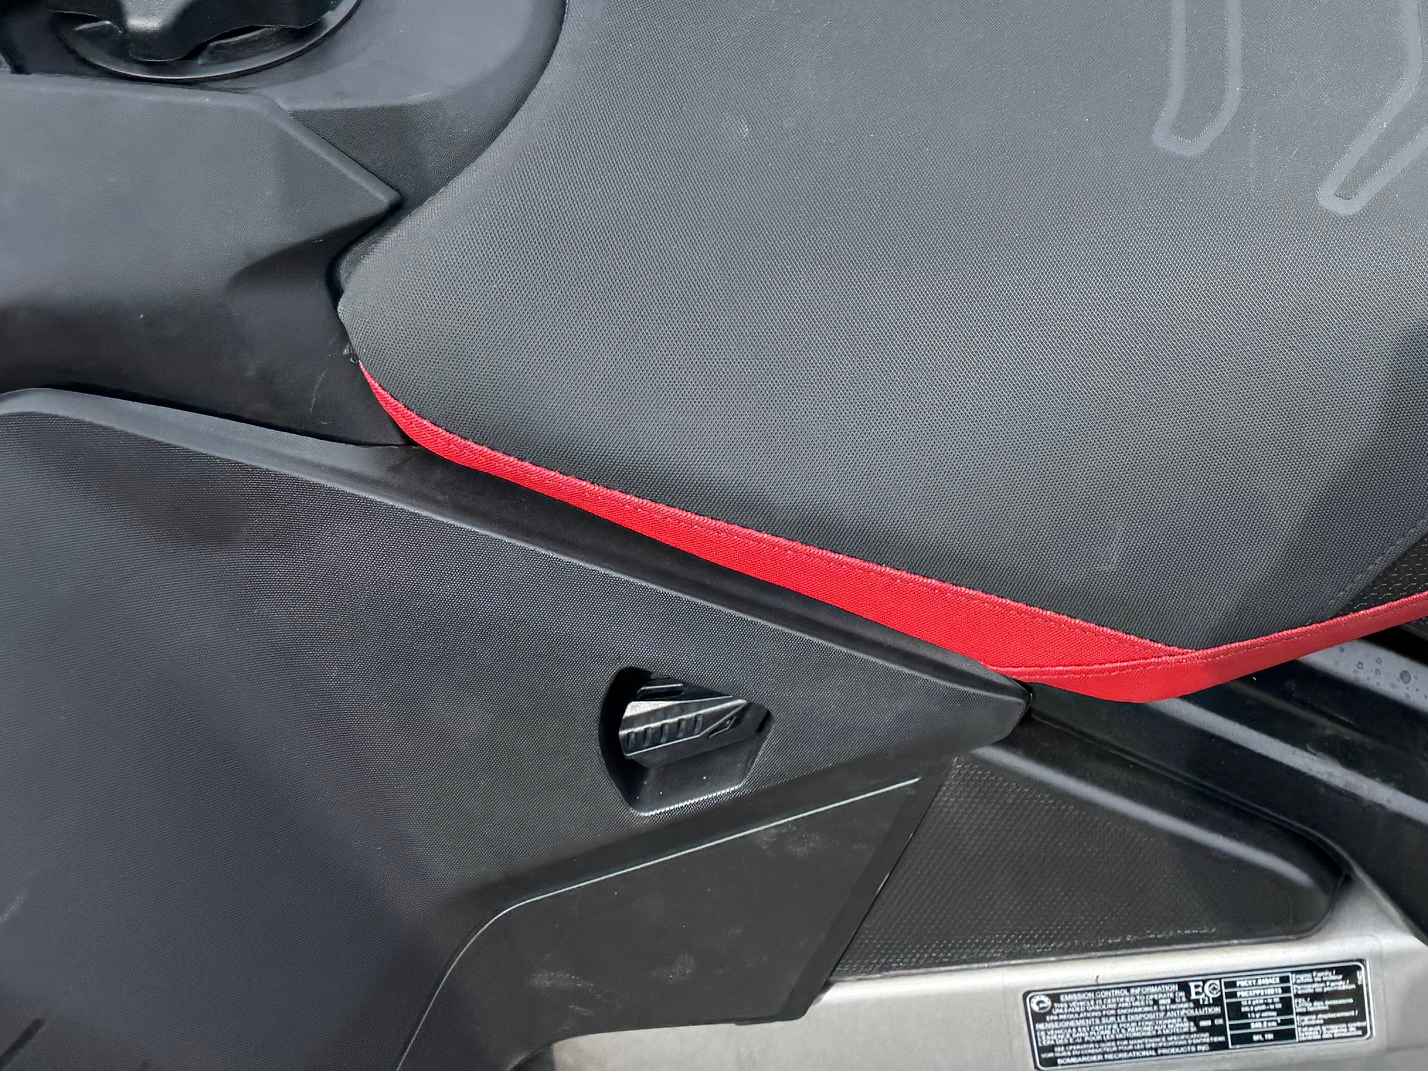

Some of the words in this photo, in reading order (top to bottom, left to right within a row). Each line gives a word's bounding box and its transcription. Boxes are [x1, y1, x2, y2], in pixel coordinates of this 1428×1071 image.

[1059, 991, 1094, 1001] EMISSION
[1094, 988, 1129, 998] CONTROL
[1130, 983, 1178, 995] INFORMATION
